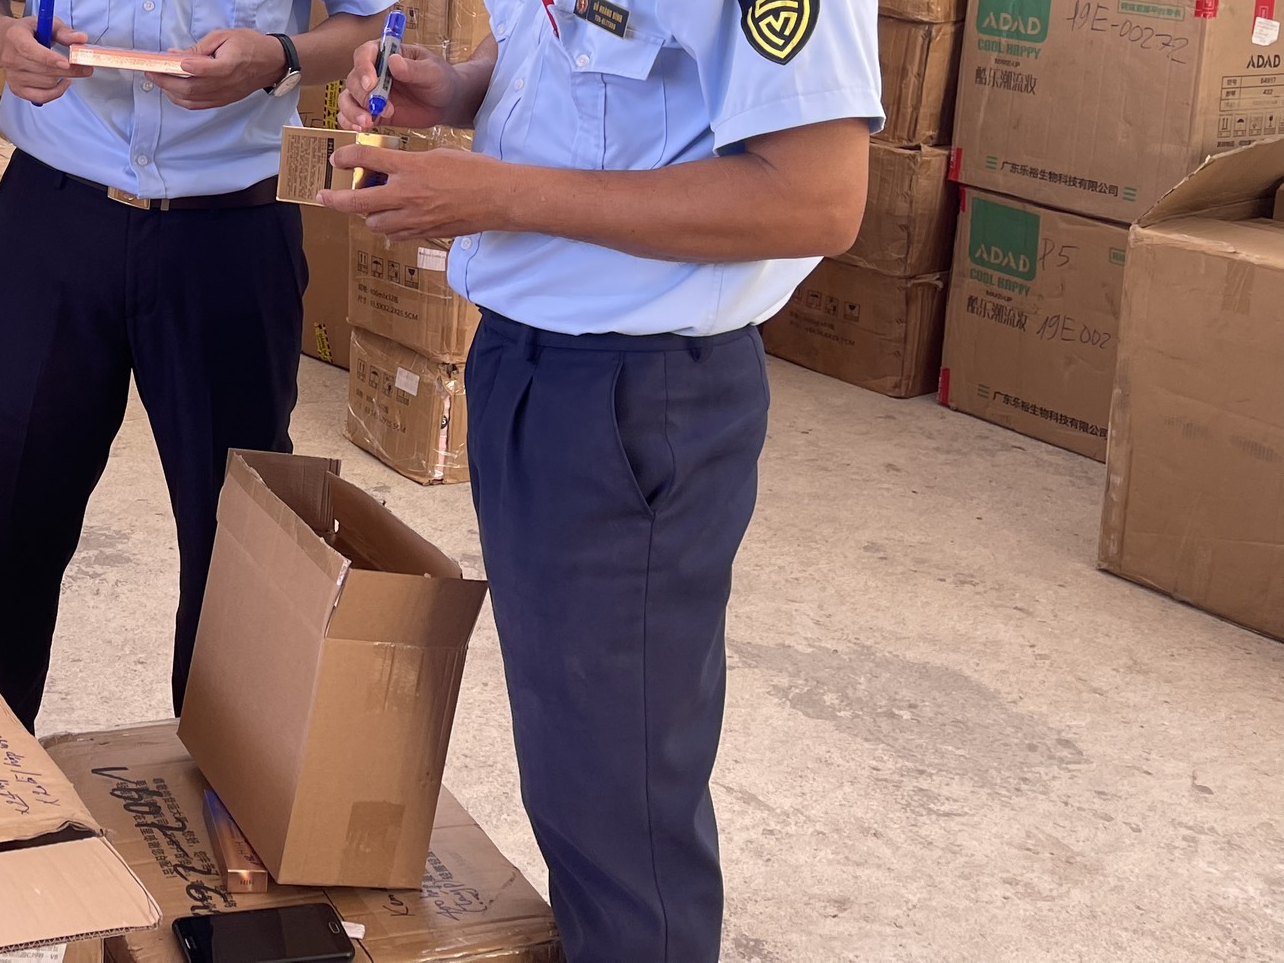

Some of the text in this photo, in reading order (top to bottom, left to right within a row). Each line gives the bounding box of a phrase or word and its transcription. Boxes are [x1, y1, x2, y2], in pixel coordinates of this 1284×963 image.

[982, 11, 1042, 36] ADAD
[977, 38, 1004, 54] COOL
[1246, 54, 1281, 70] ADAD
[975, 243, 1031, 273] ADAD
